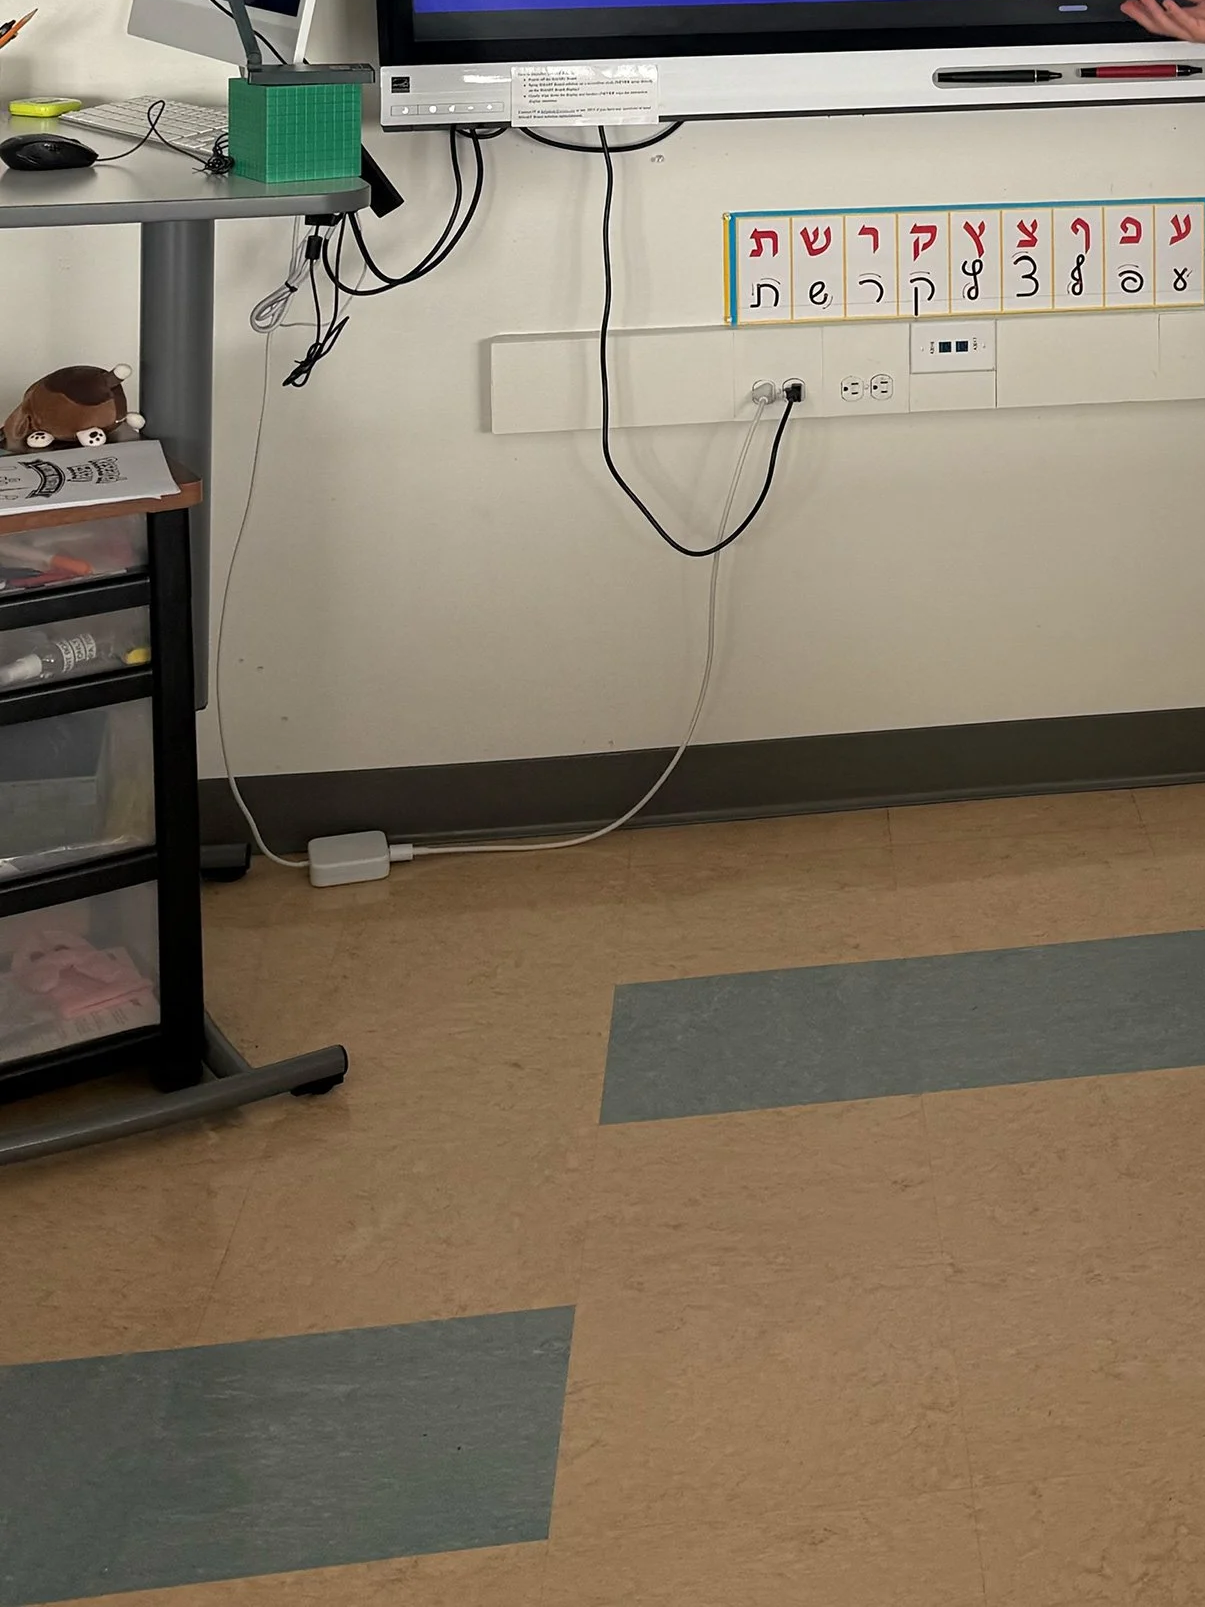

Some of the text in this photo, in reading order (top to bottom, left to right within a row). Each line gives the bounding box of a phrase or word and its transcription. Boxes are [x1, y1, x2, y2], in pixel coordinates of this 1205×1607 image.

[749, 227, 779, 258] ת
[799, 225, 832, 257] ש
[910, 223, 937, 262] ק
